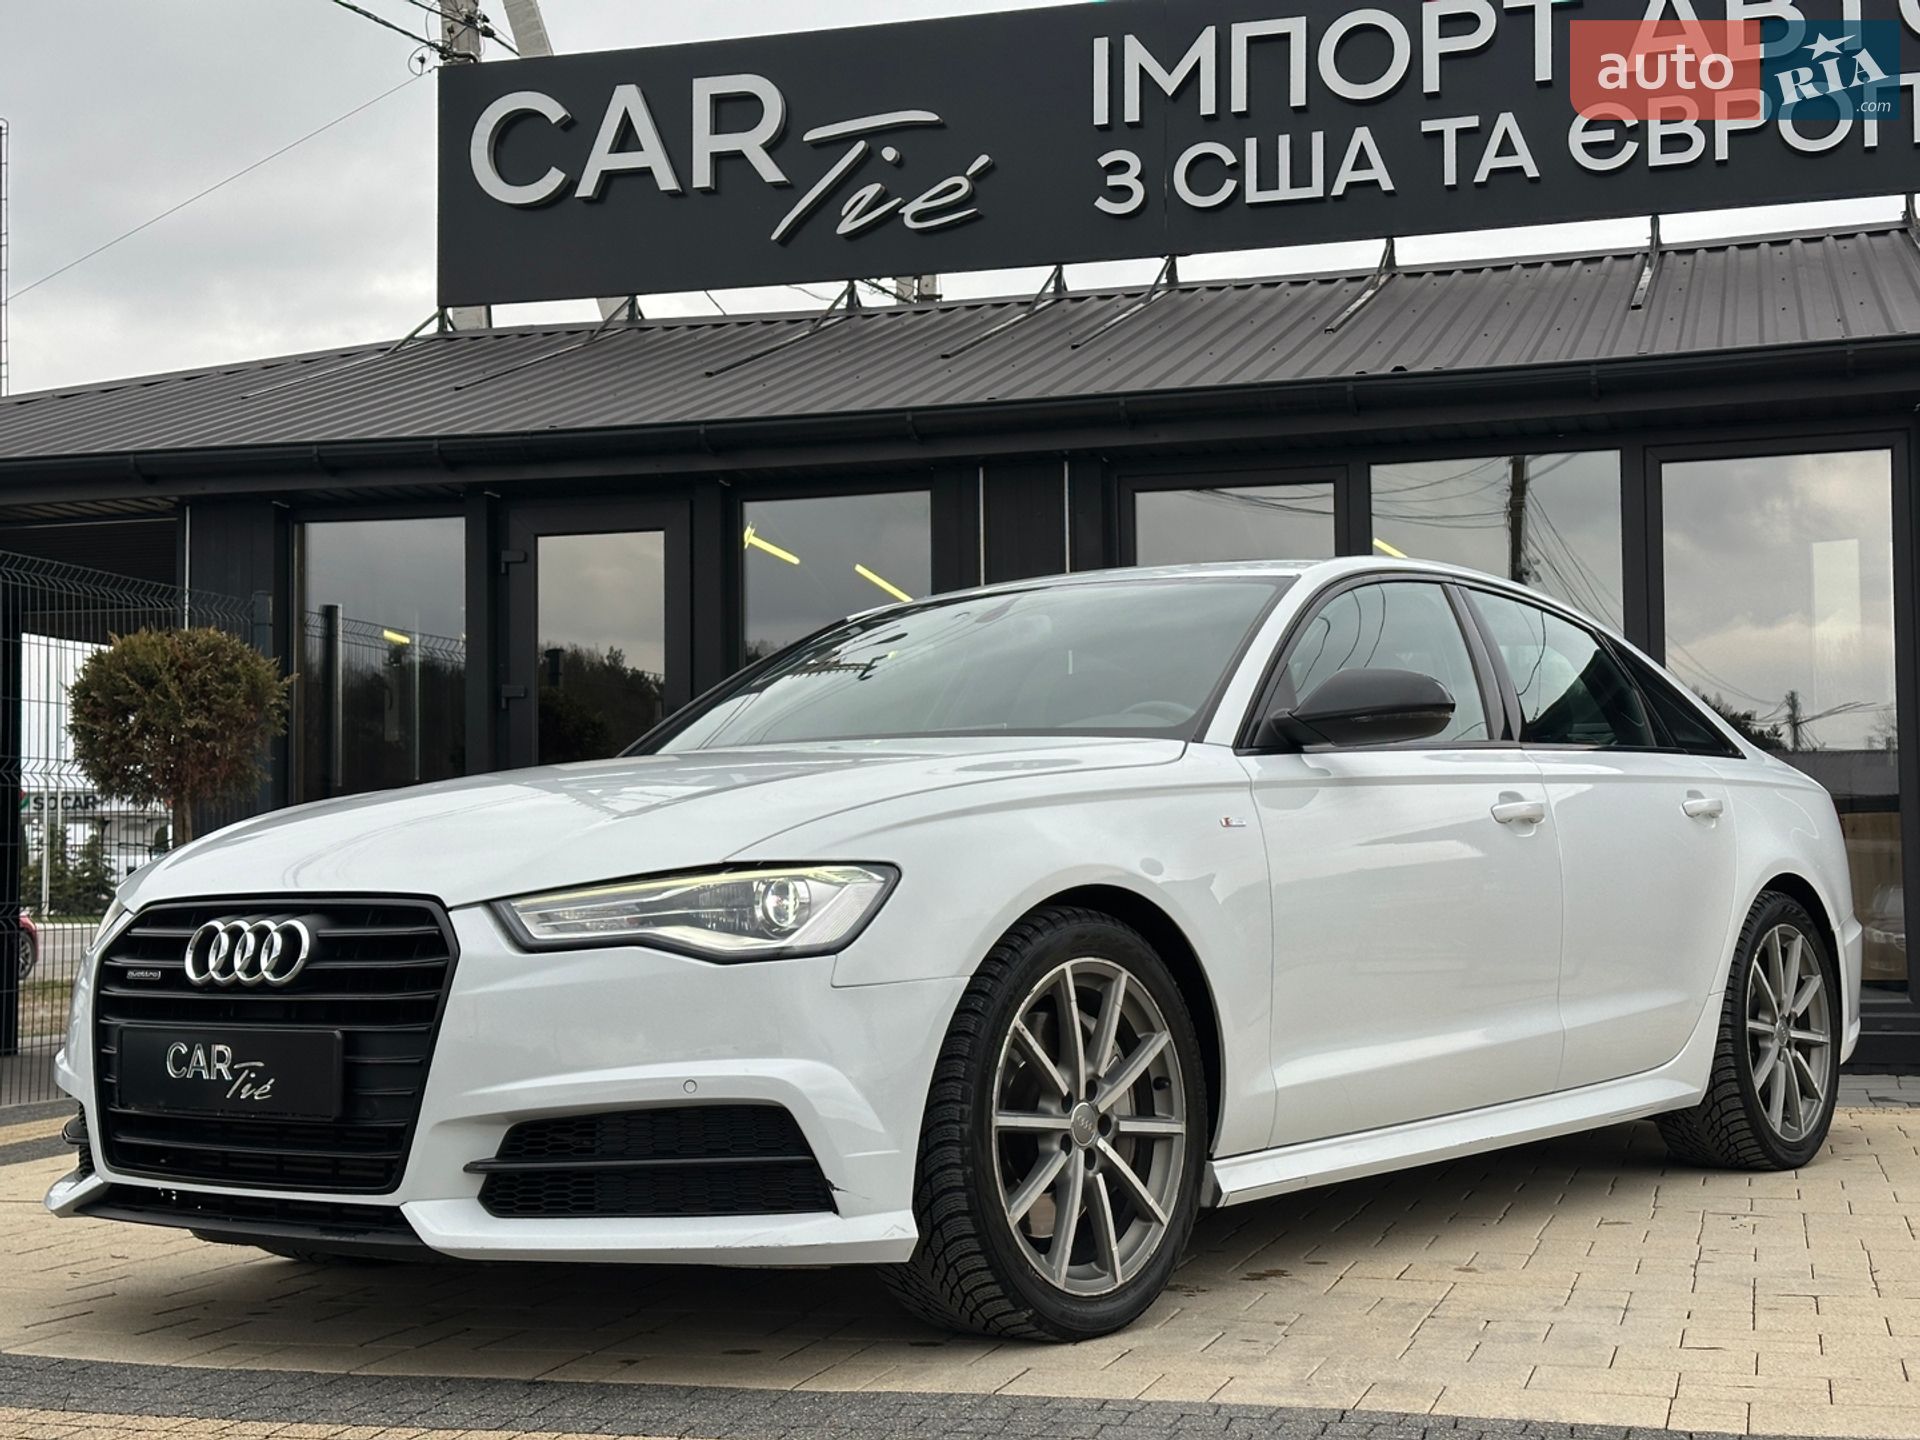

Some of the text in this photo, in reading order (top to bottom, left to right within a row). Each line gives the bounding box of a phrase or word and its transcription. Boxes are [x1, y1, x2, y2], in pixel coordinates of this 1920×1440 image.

[1093, 0, 1582, 126] ІМПОРТ
[470, 73, 791, 205] CAR
[1173, 126, 1396, 208] США
[1420, 112, 1541, 186] ТА
[33, 795, 97, 811] SOCAR
[166, 1042, 233, 1080] CAR
